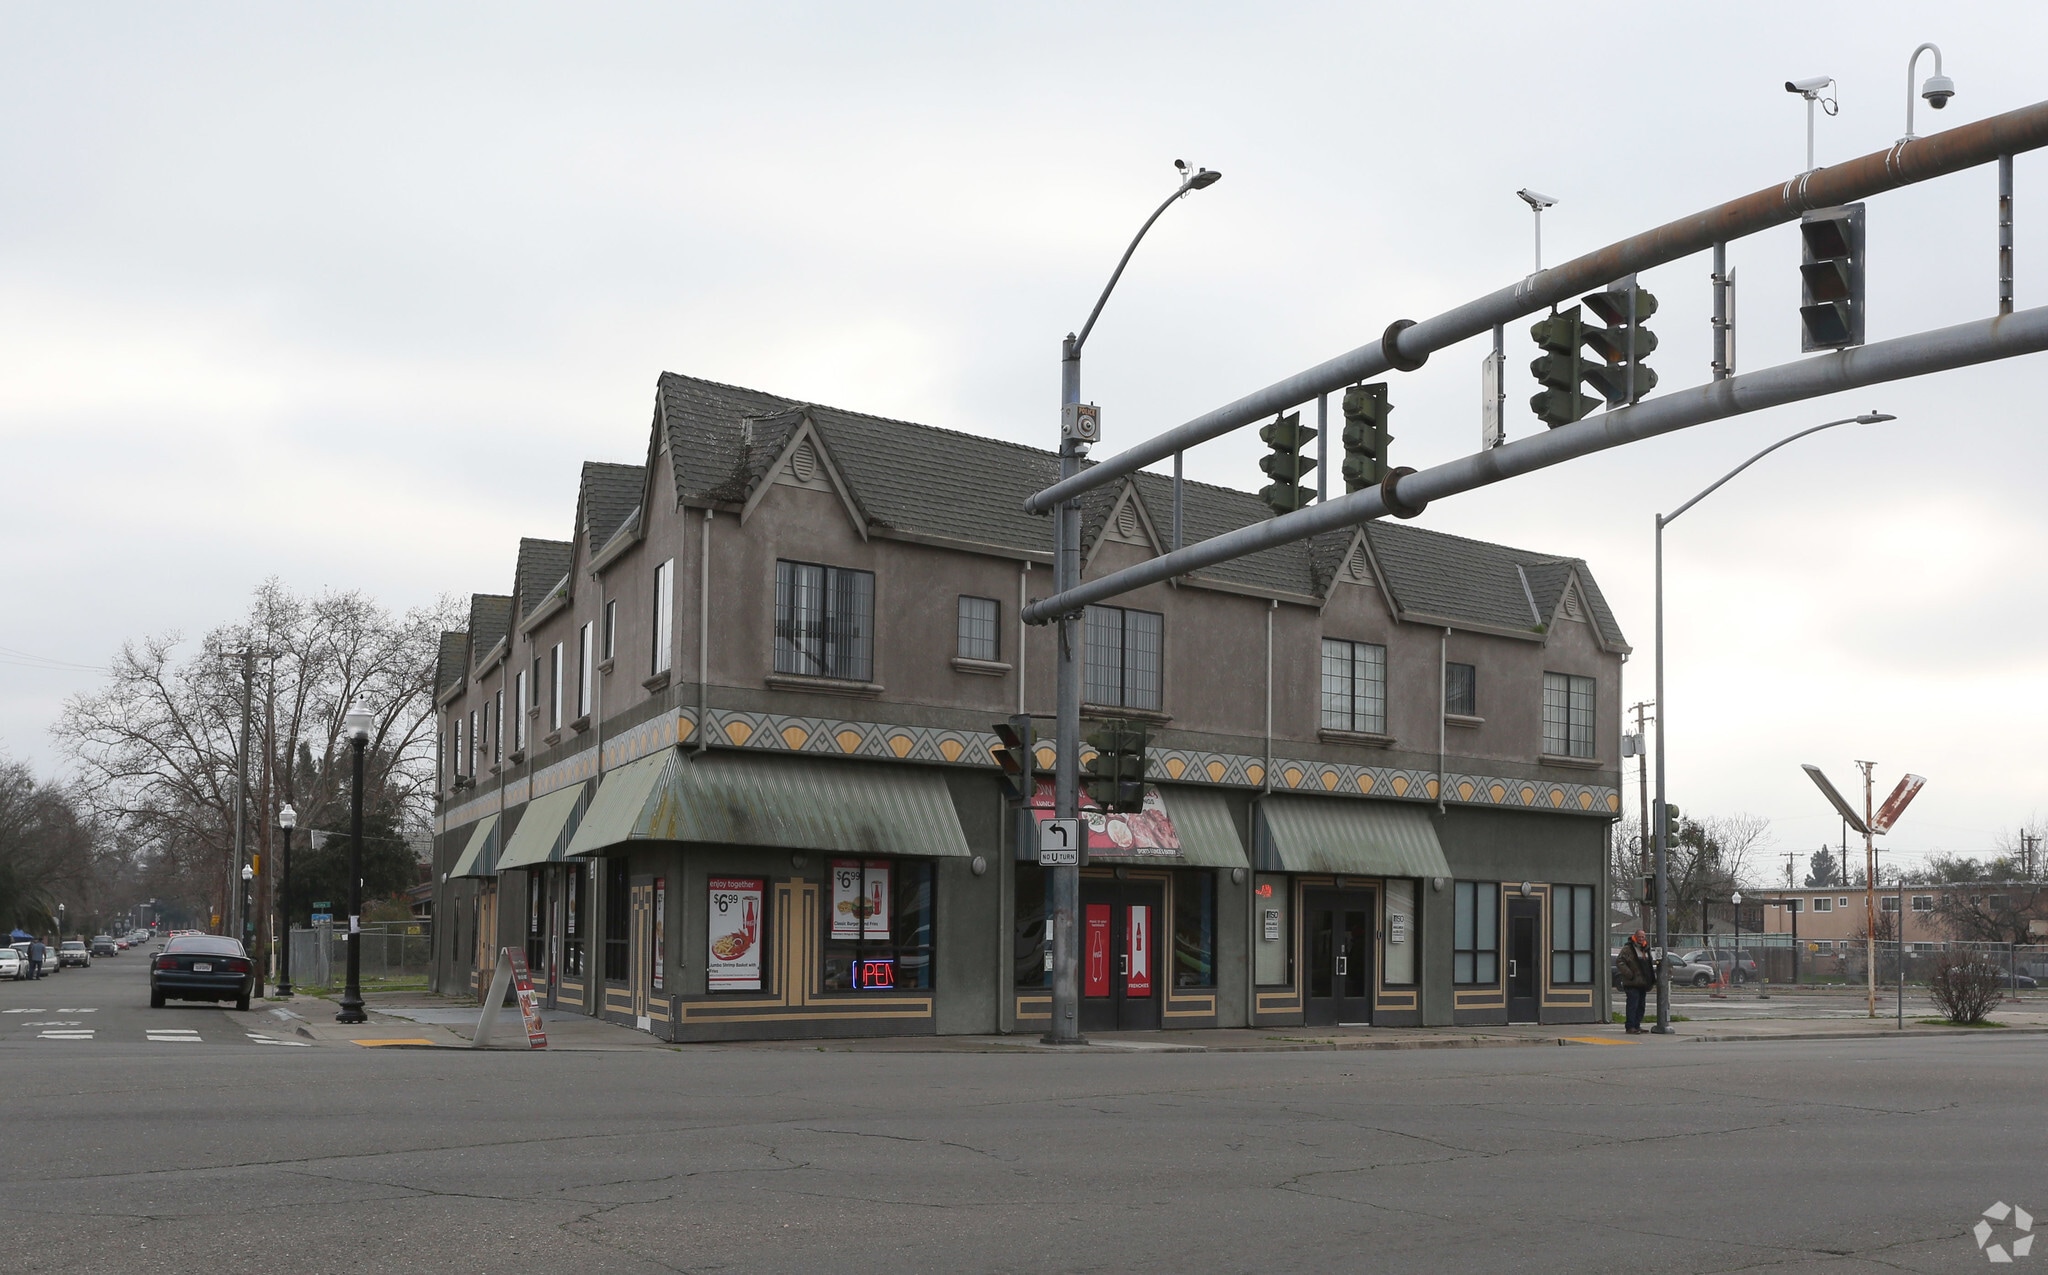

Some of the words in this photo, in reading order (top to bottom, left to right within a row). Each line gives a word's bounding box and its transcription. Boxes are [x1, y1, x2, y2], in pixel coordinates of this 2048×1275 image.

[1078, 407, 1096, 417] POLICE
[1051, 852, 1058, 862] U
[709, 880, 727, 888] enjoy
[727, 881, 754, 889] together
